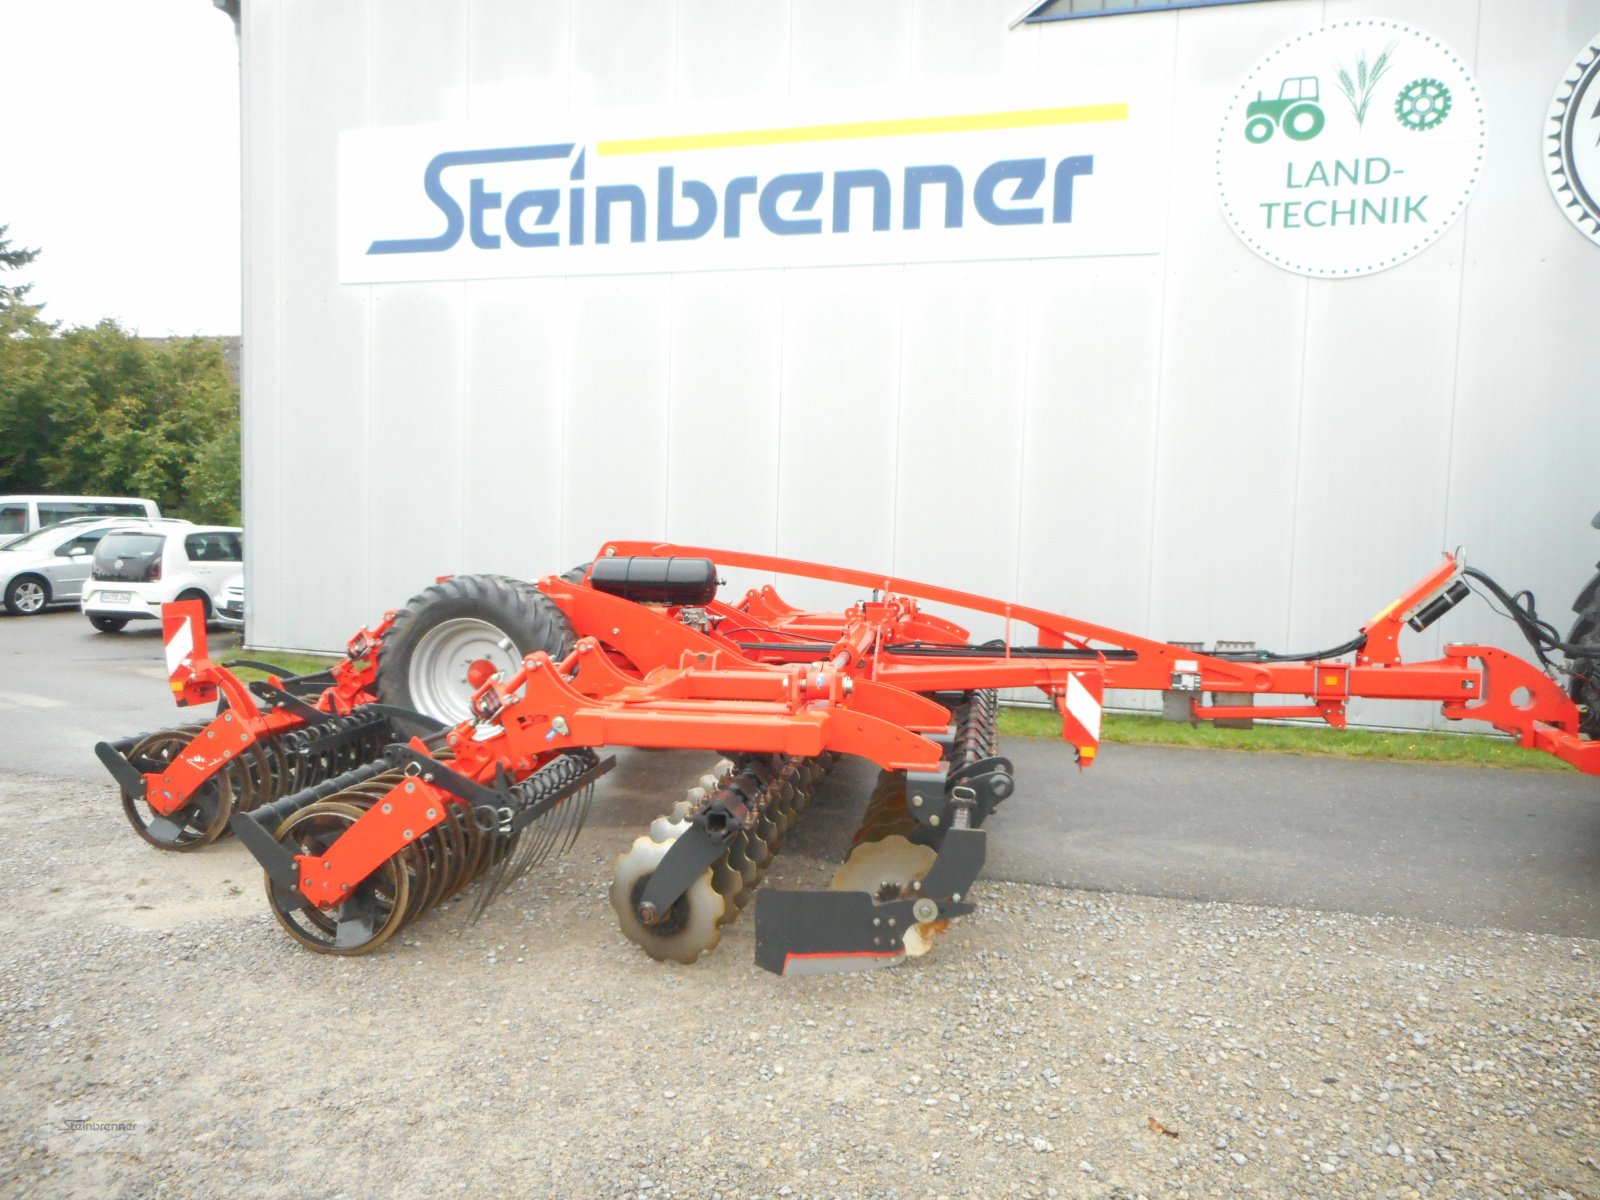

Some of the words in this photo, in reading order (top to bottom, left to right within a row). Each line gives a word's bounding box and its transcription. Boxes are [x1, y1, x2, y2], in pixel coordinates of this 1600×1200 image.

[1287, 157, 1404, 189] LAND-
[365, 143, 1094, 255] Steinbrenner
[1259, 196, 1429, 229] TECHNIK
